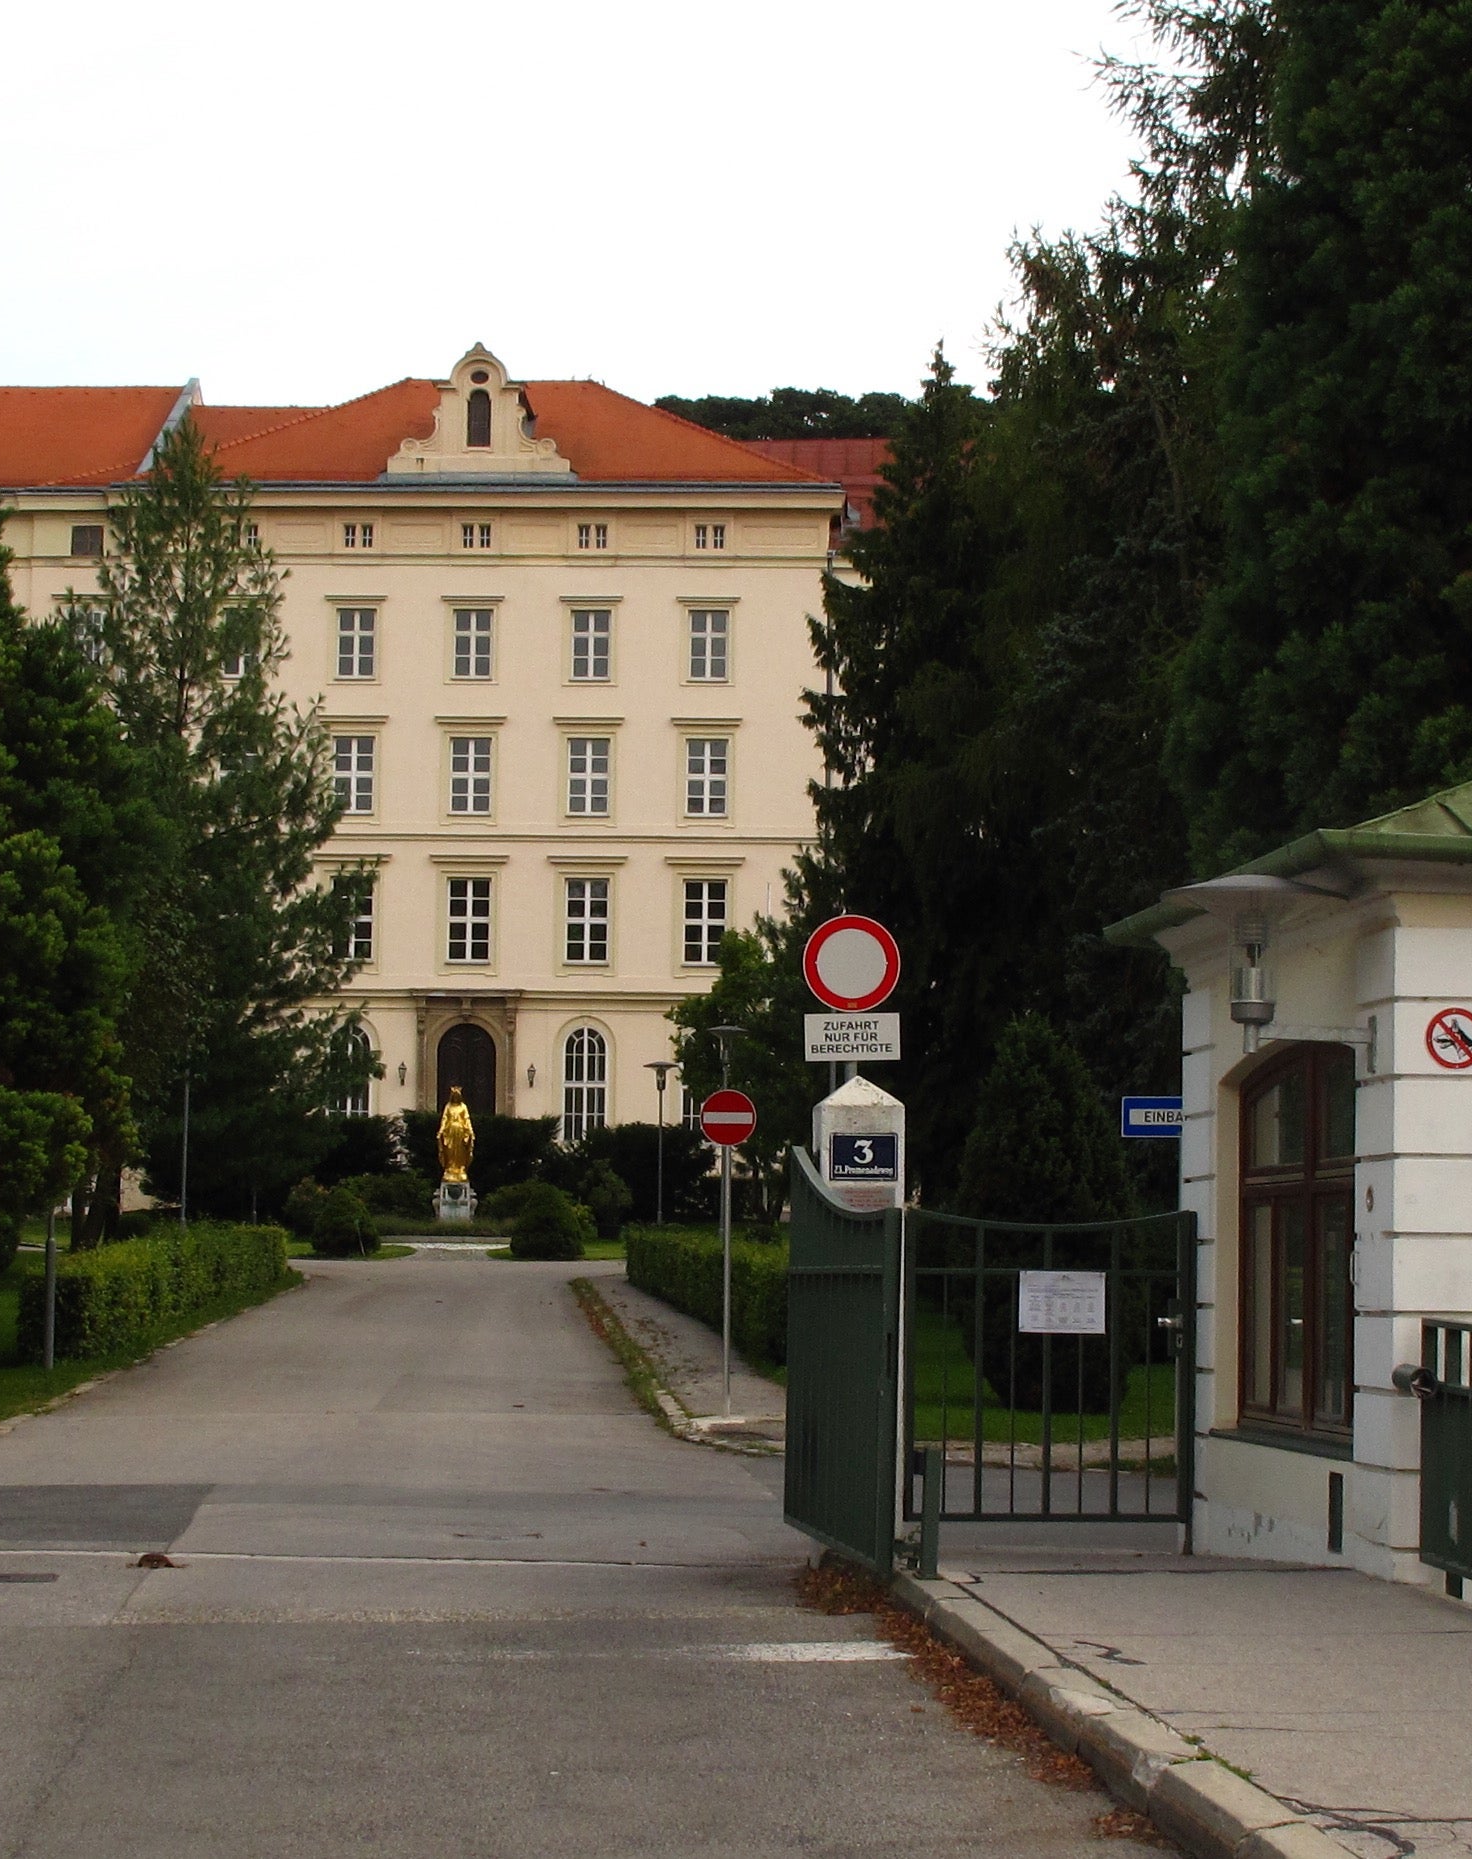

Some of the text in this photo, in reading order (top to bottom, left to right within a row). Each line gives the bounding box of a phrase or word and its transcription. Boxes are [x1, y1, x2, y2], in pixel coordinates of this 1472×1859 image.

[823, 1021, 879, 1031] ZUFAHRT
[824, 1031, 878, 1042] NUR FÜR
[811, 1043, 893, 1054] BERECHTIGTE
[853, 1140, 874, 1165] 3
